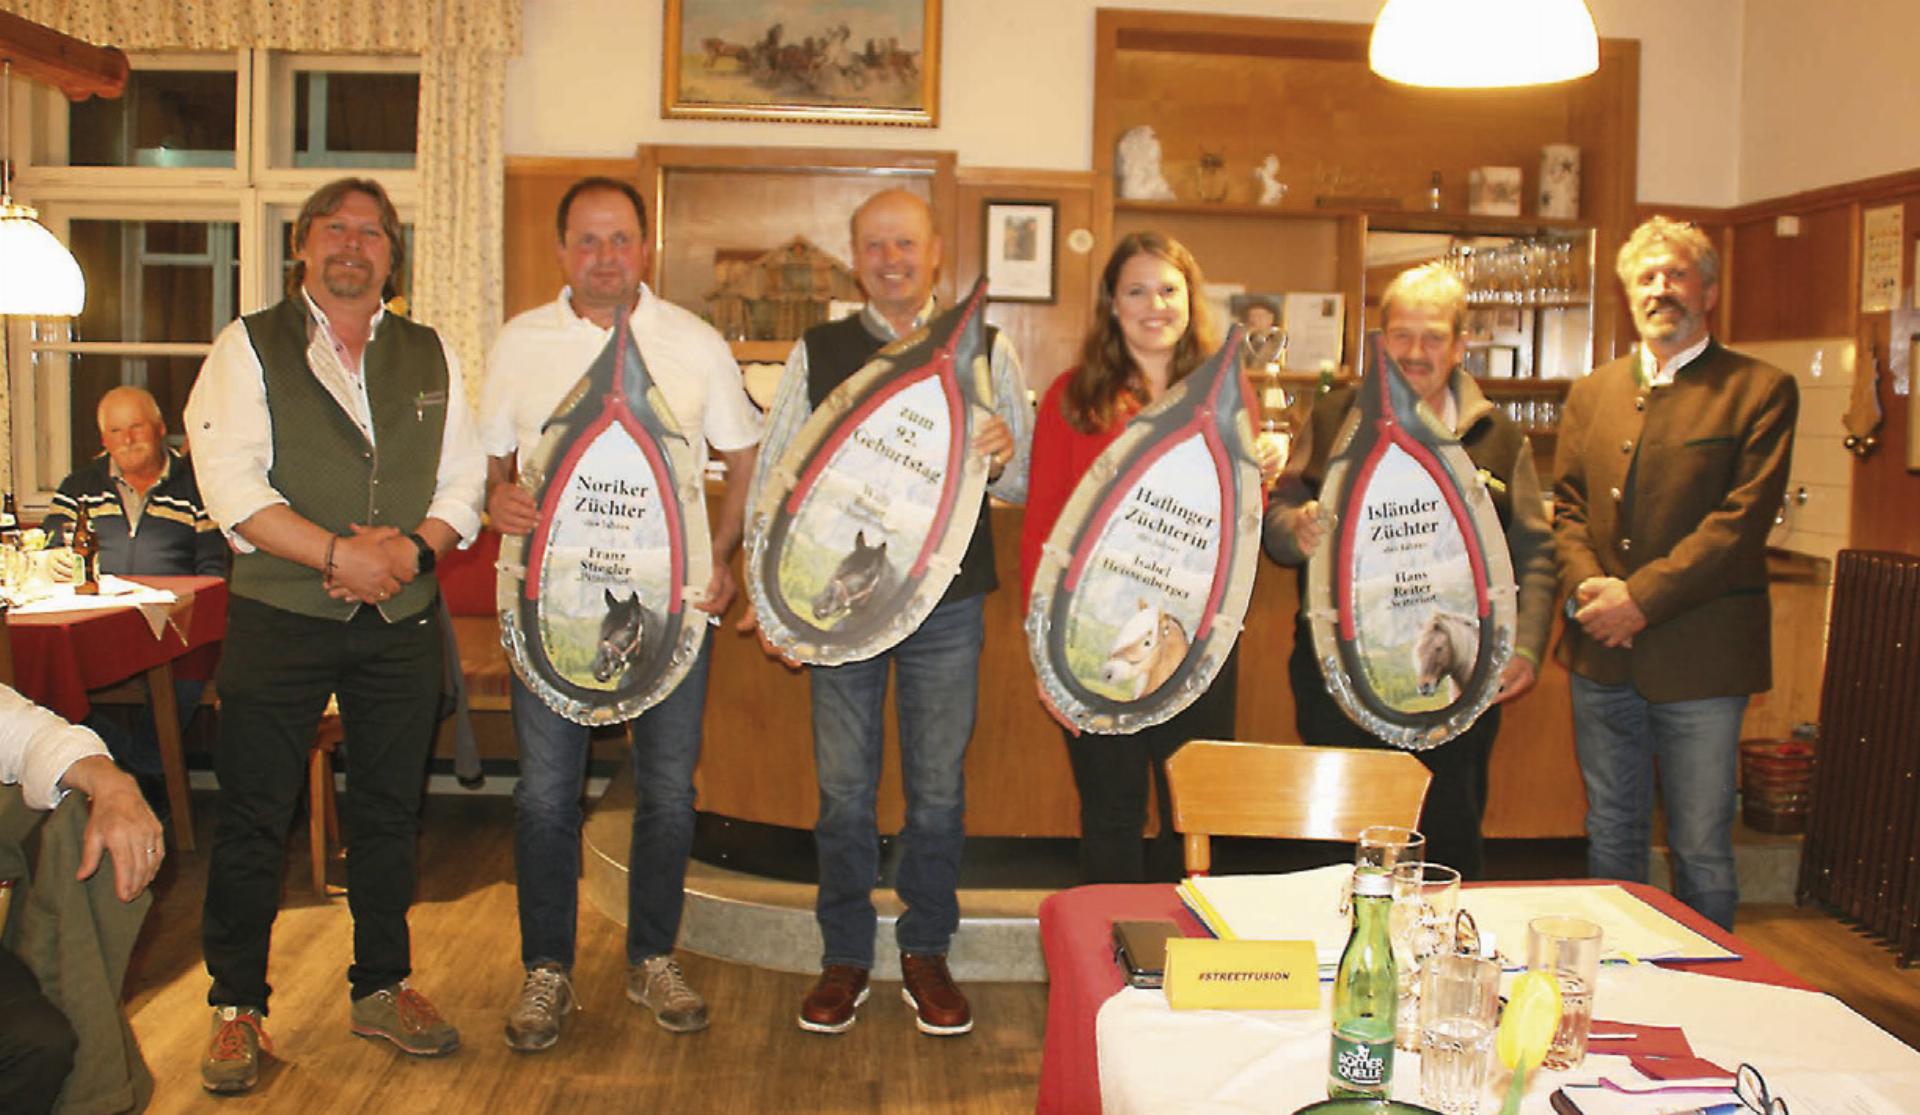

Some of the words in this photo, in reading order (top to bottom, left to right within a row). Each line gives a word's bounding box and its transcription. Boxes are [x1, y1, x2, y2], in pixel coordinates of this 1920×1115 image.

[899, 407, 934, 431] zum
[896, 425, 917, 447] 92.
[854, 429, 941, 485] Geburtstag
[577, 475, 648, 498] Noriker
[575, 496, 646, 518] Züchter
[1136, 486, 1214, 529] Haflinger
[1368, 498, 1439, 520] Isländer
[1124, 505, 1208, 551] Züchterin
[1370, 521, 1439, 541] Züchter
[589, 547, 626, 561] Franz
[580, 560, 632, 577] Stiegler
[1133, 553, 1173, 579] Isabel
[1394, 571, 1428, 583] Hans
[1392, 584, 1432, 598] Reiter
[1198, 971, 1291, 982] #STREETFUSION
[1338, 1064, 1383, 1080] QUELLE
